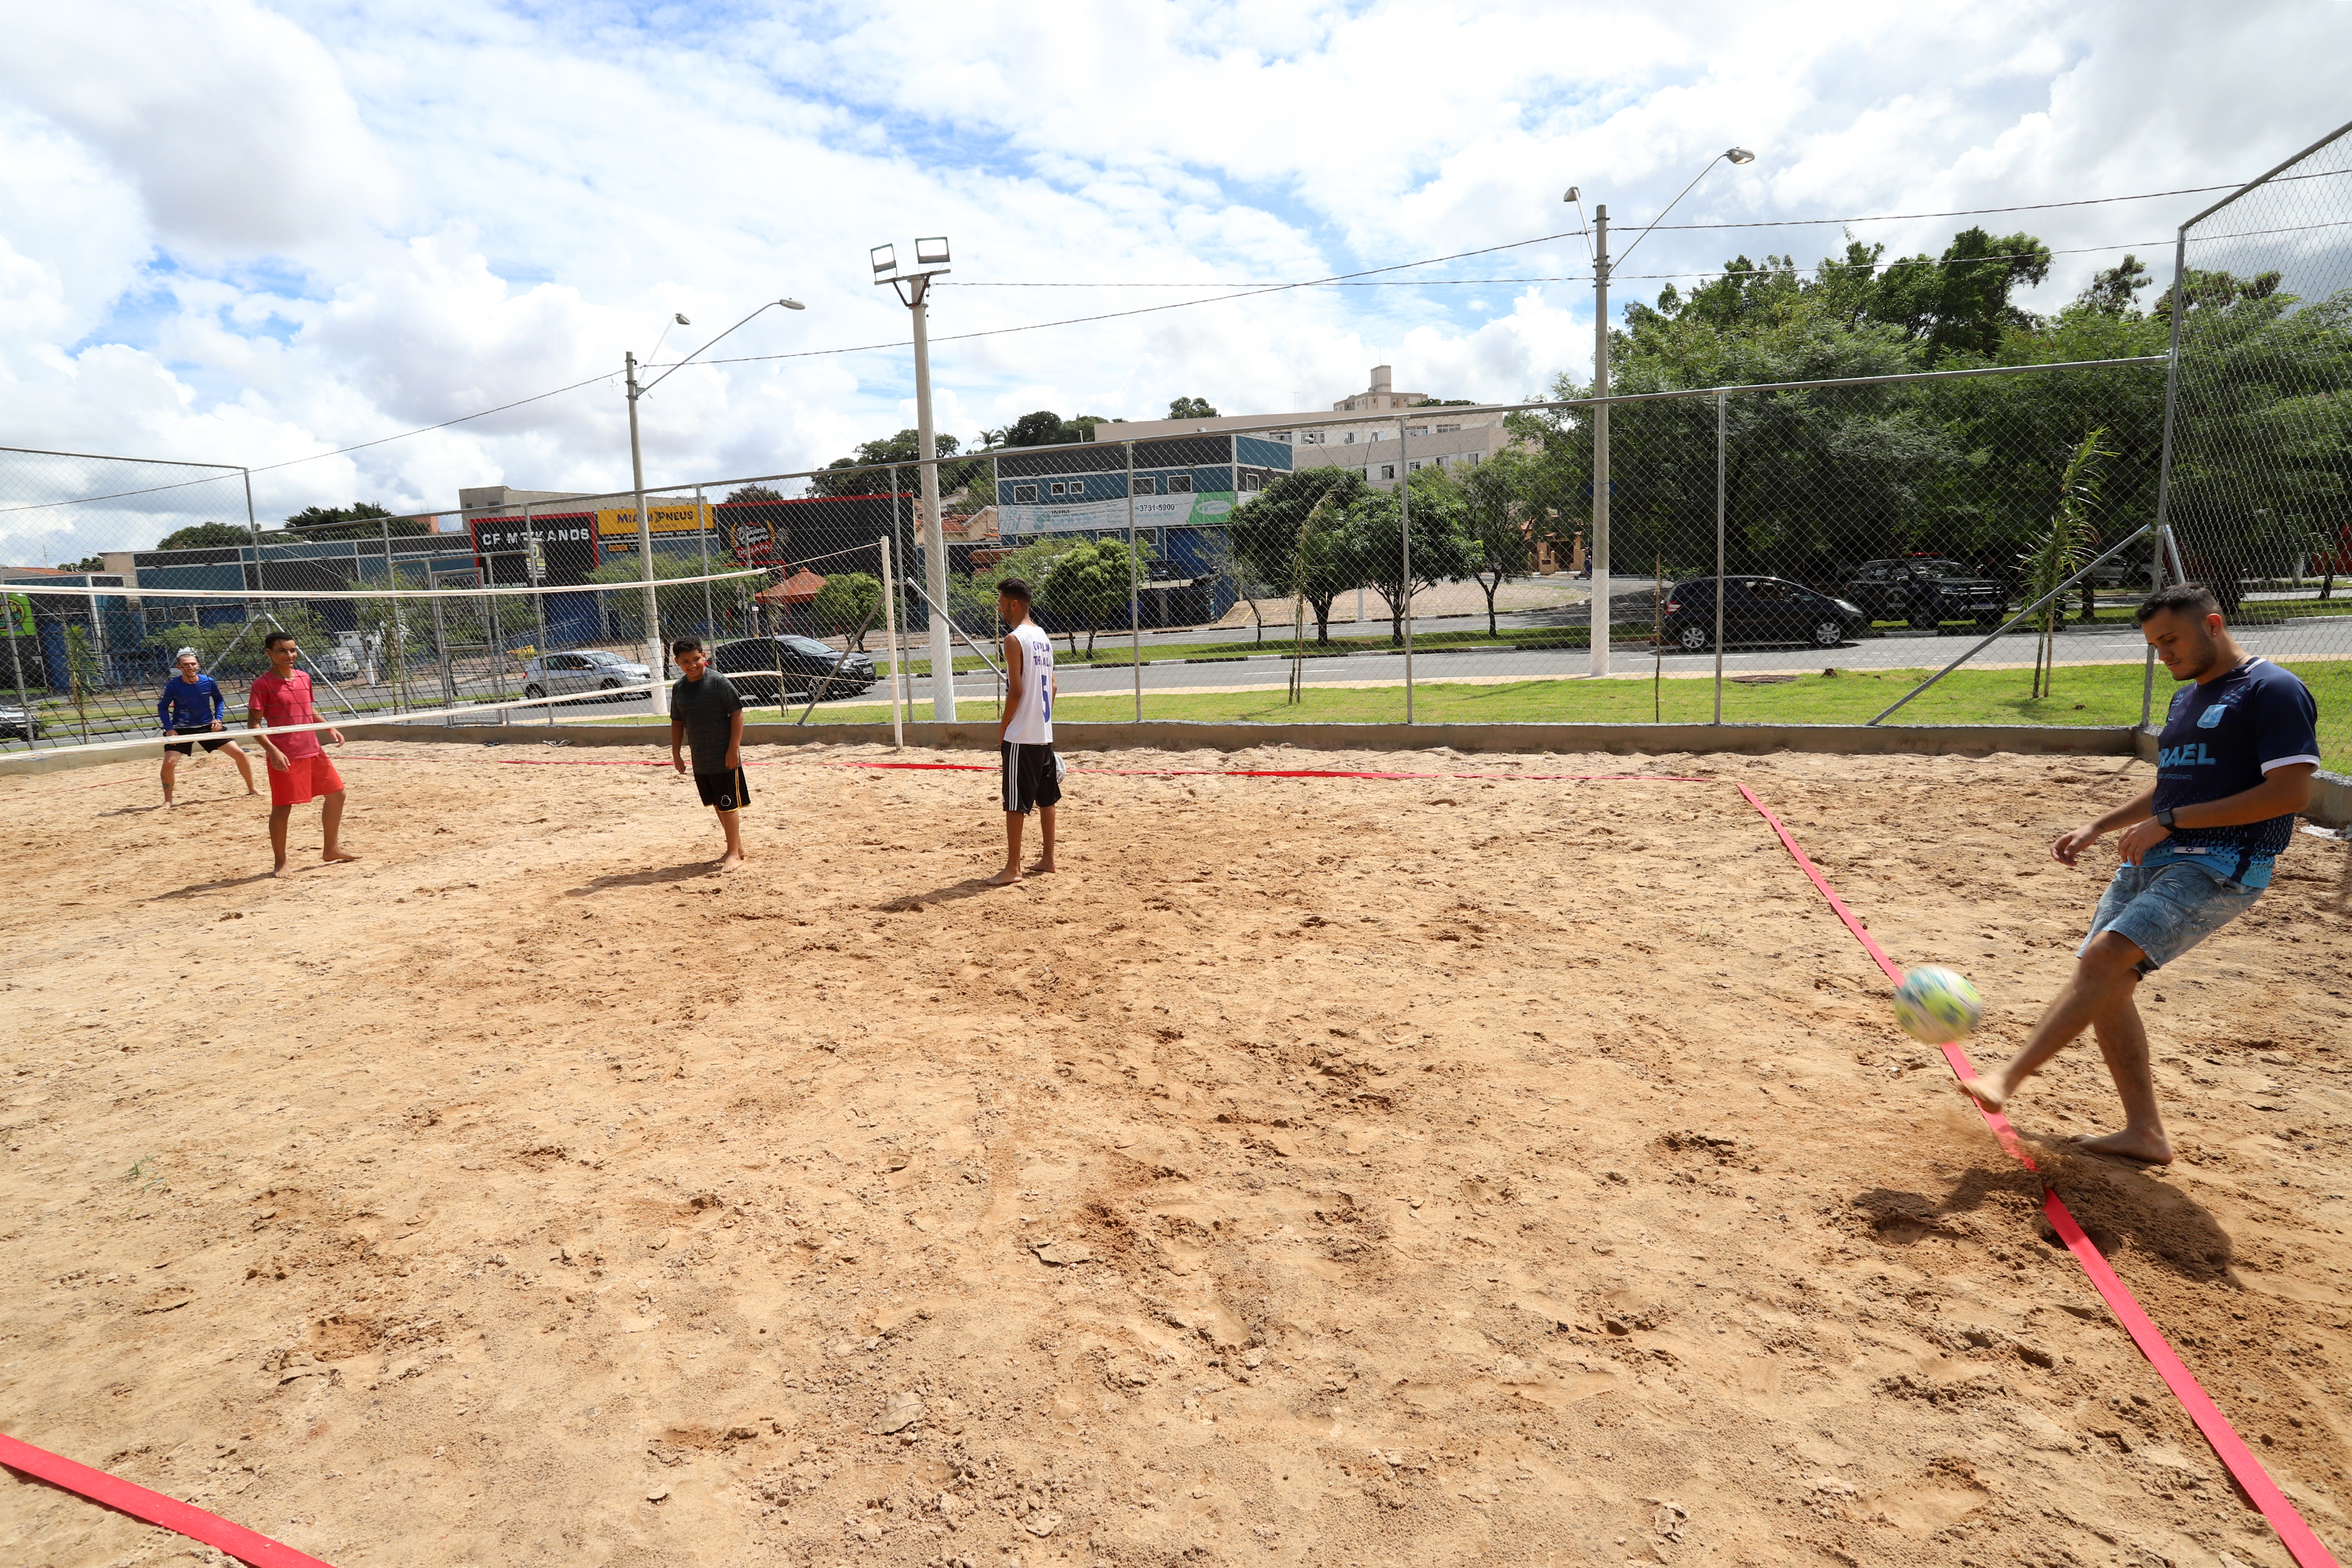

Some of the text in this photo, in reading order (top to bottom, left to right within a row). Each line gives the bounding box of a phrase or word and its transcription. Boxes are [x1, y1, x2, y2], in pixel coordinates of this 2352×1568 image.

[1139, 503, 1175, 512] 3731-5900
[617, 510, 694, 524] MIAI PNEUS
[482, 533, 501, 546] CF
[1041, 674, 1051, 724] 5
